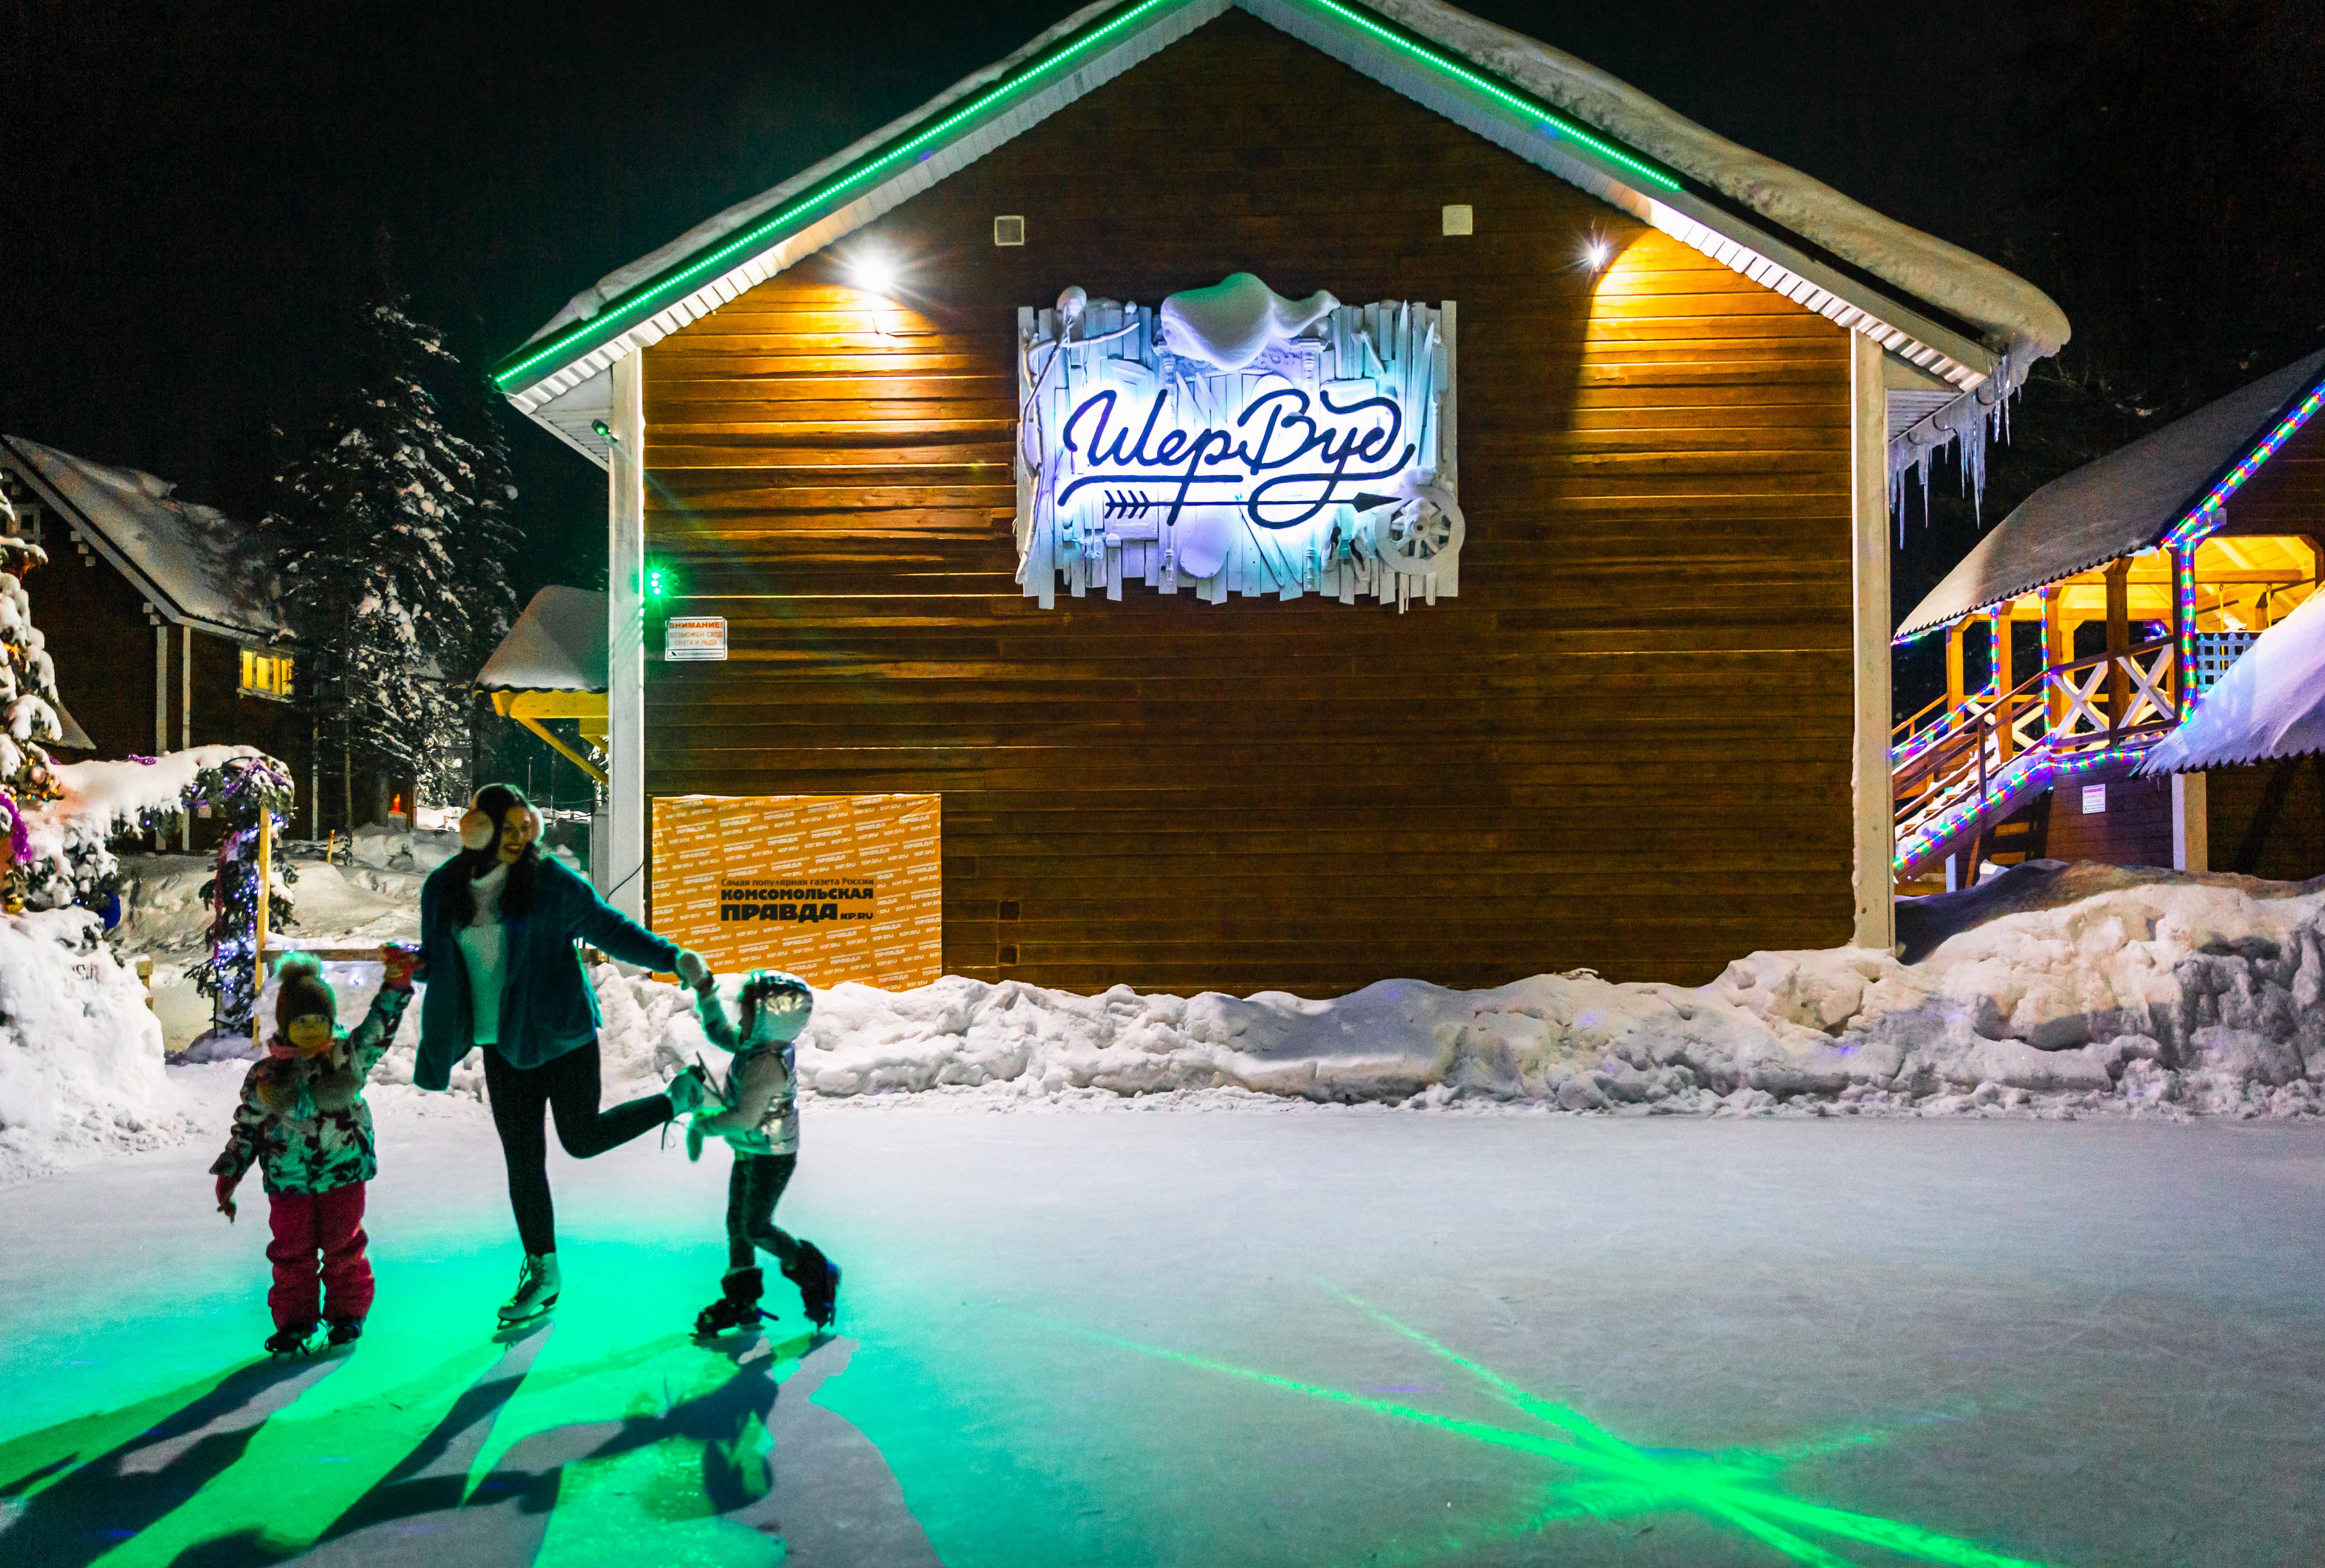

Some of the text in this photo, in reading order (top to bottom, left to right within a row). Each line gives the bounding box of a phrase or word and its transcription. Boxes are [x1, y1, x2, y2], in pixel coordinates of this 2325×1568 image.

[752, 878, 807, 887] популярная
[721, 888, 873, 900] КОМСОМОЛЬСКАЯ
[721, 903, 838, 923] ПРАВДА
